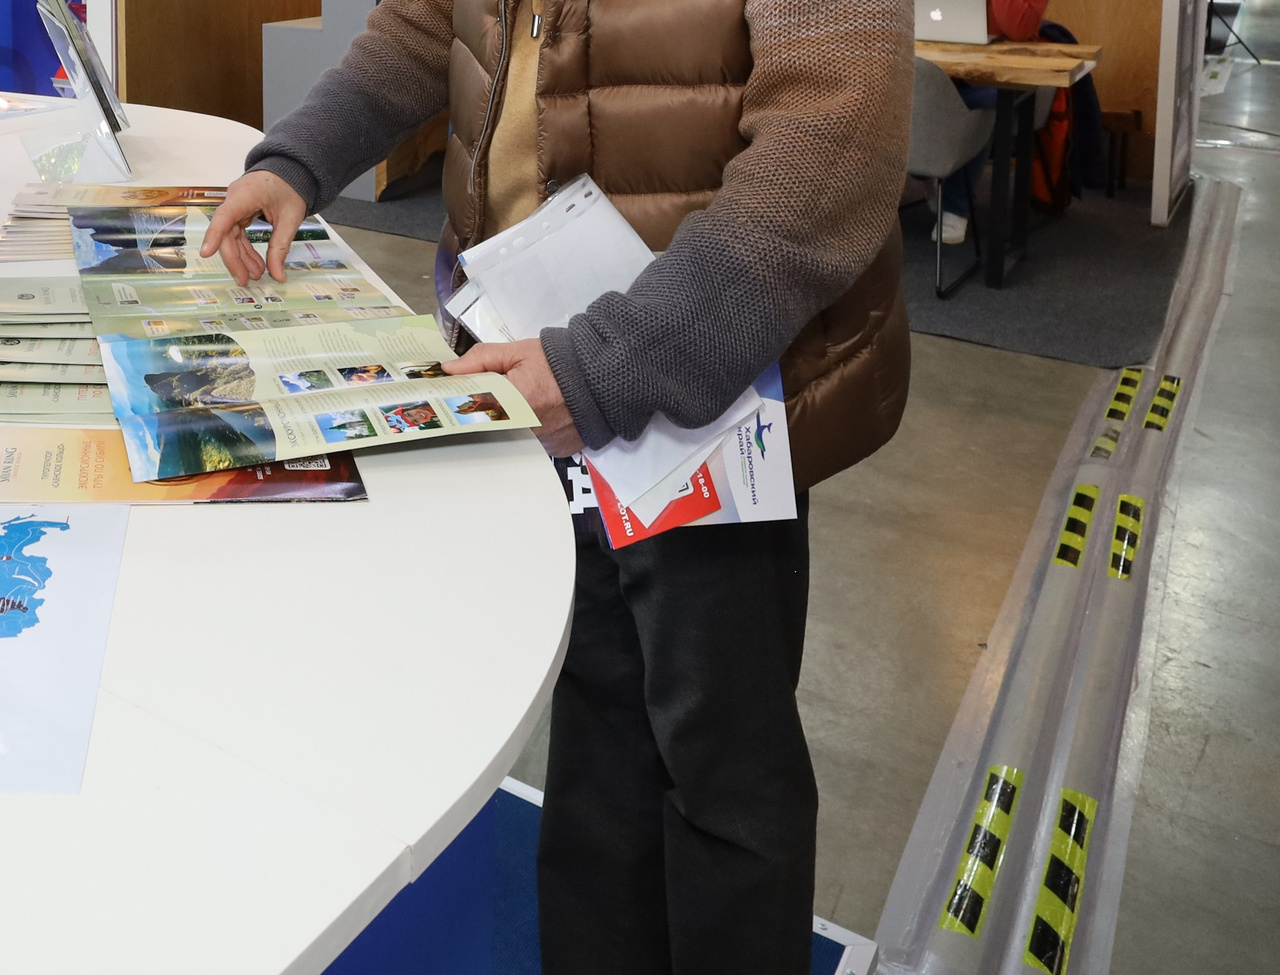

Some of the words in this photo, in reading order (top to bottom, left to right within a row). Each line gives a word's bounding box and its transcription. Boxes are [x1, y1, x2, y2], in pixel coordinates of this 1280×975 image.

[736, 426, 747, 455] край
[744, 426, 760, 506] Хабаровский
[616, 499, 635, 538] LOT.RU
